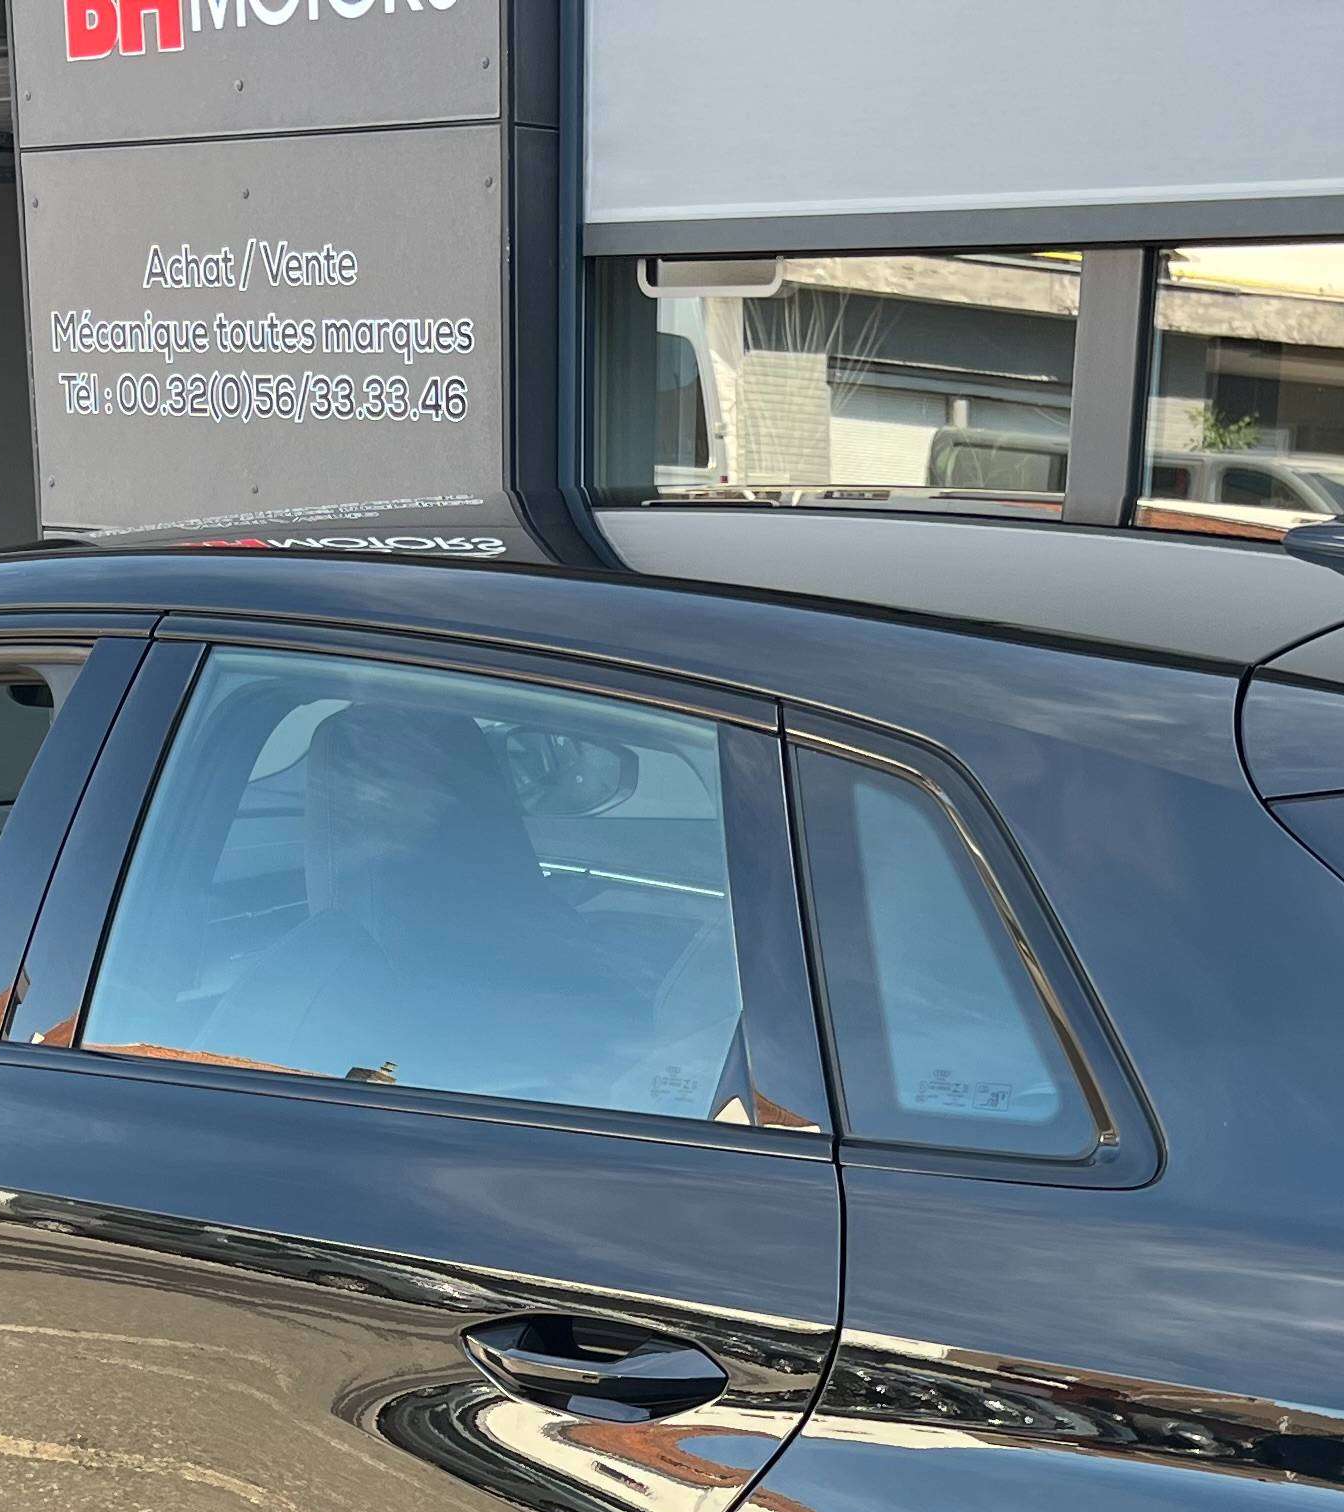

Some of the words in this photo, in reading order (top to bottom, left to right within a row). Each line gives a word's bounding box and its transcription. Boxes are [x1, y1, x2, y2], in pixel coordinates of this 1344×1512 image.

[143, 244, 235, 288] Achat
[259, 241, 358, 286] Vente
[51, 310, 209, 363] Mécanique
[214, 313, 316, 354] toutes
[322, 318, 474, 364] marques
[117, 371, 468, 423] 00.32(0)56/33.33.46
